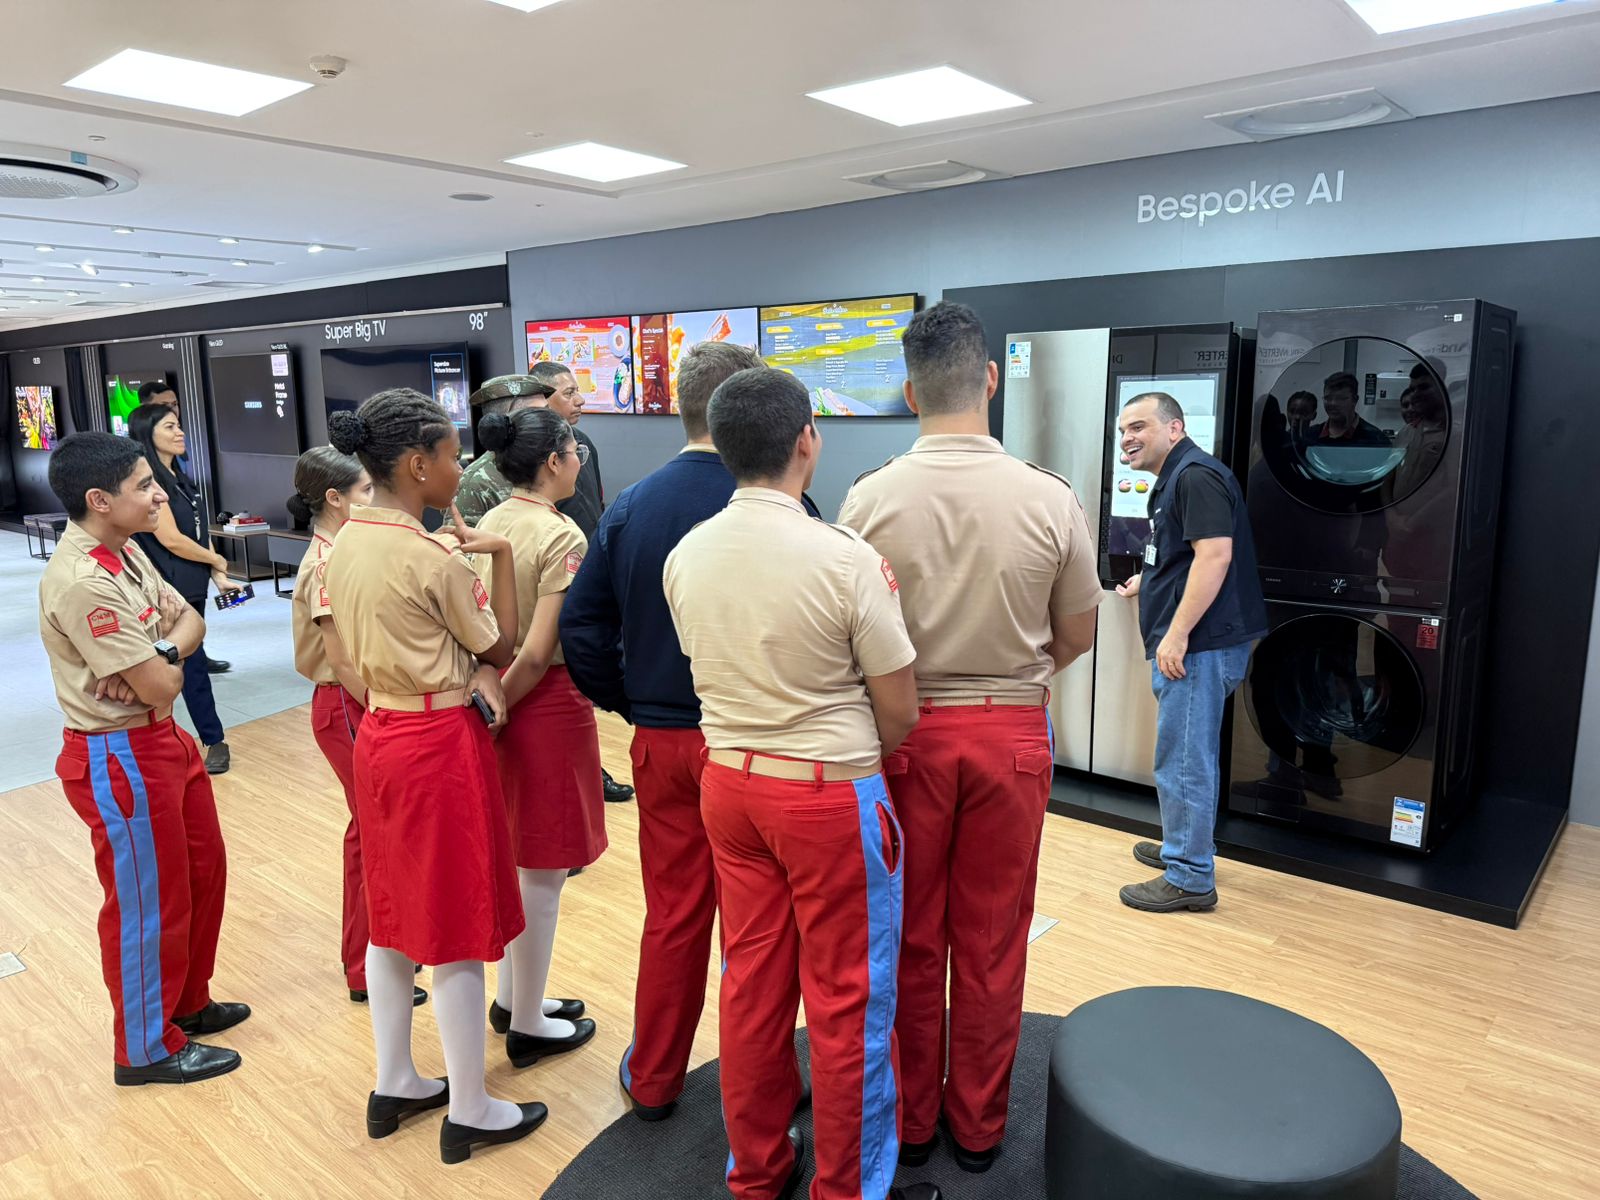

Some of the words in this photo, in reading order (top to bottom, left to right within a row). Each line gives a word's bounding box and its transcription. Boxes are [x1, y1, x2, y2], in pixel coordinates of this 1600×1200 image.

[1137, 180, 1295, 227] Bespoke
[1306, 170, 1345, 205] AI
[325, 324, 353, 344] Super
[355, 320, 372, 342] Big
[372, 319, 386, 336] TV
[1422, 626, 1434, 635] 20
